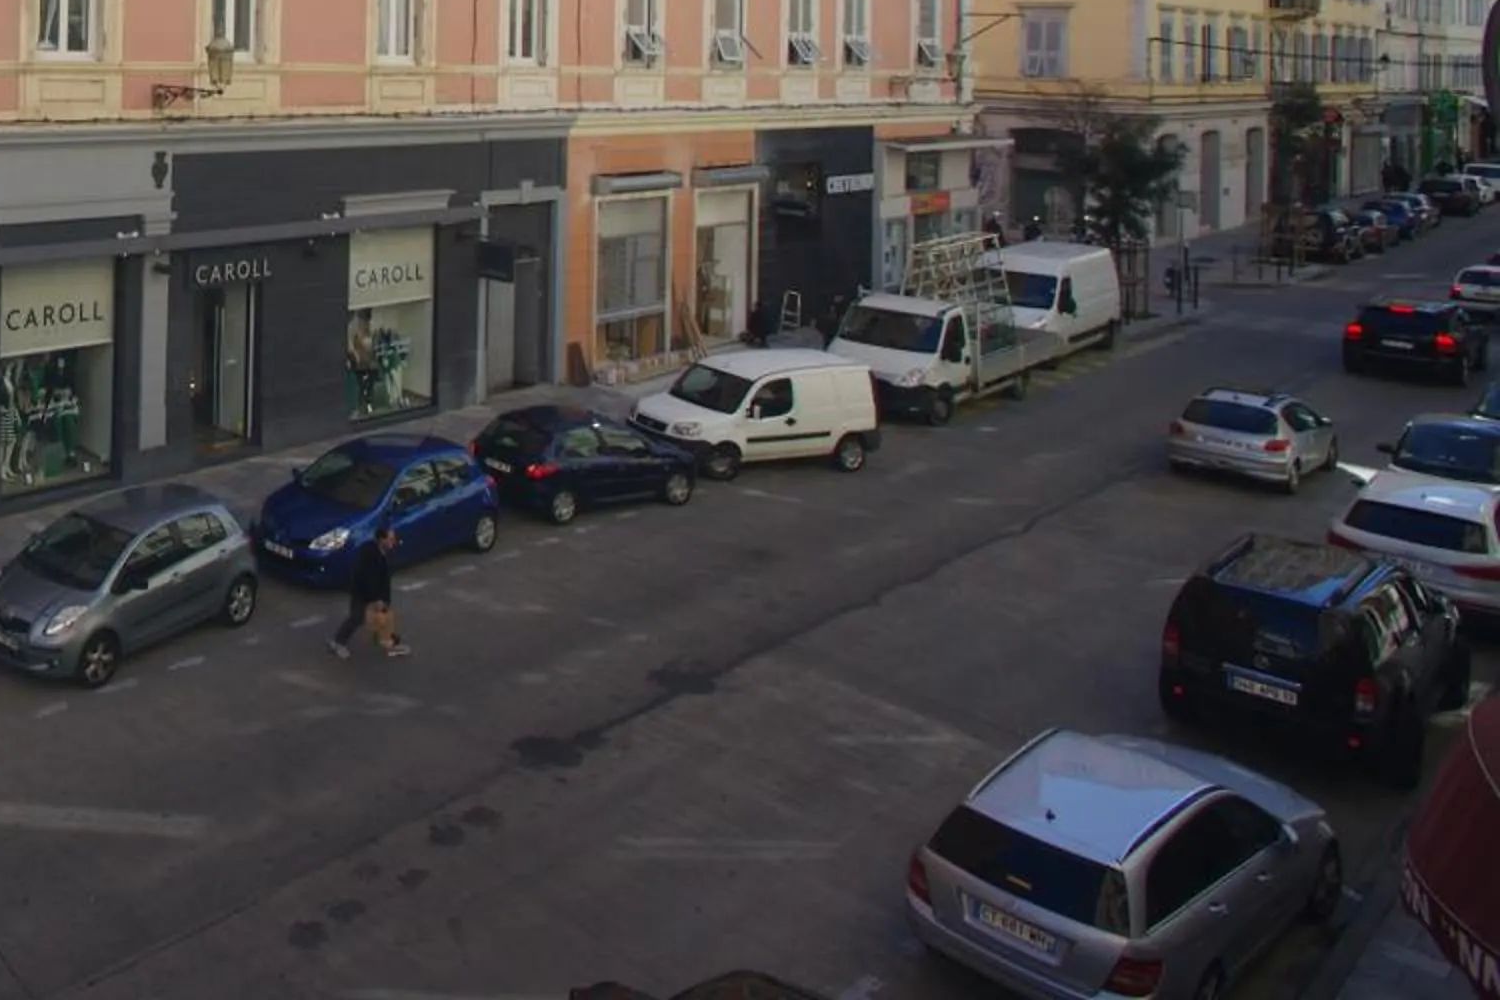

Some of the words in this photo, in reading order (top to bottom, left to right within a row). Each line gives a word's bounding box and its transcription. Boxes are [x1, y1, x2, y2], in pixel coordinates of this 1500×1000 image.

[195, 257, 272, 285] CAROLL
[355, 263, 424, 288] CAROLL
[6, 301, 104, 331] CAROLL
